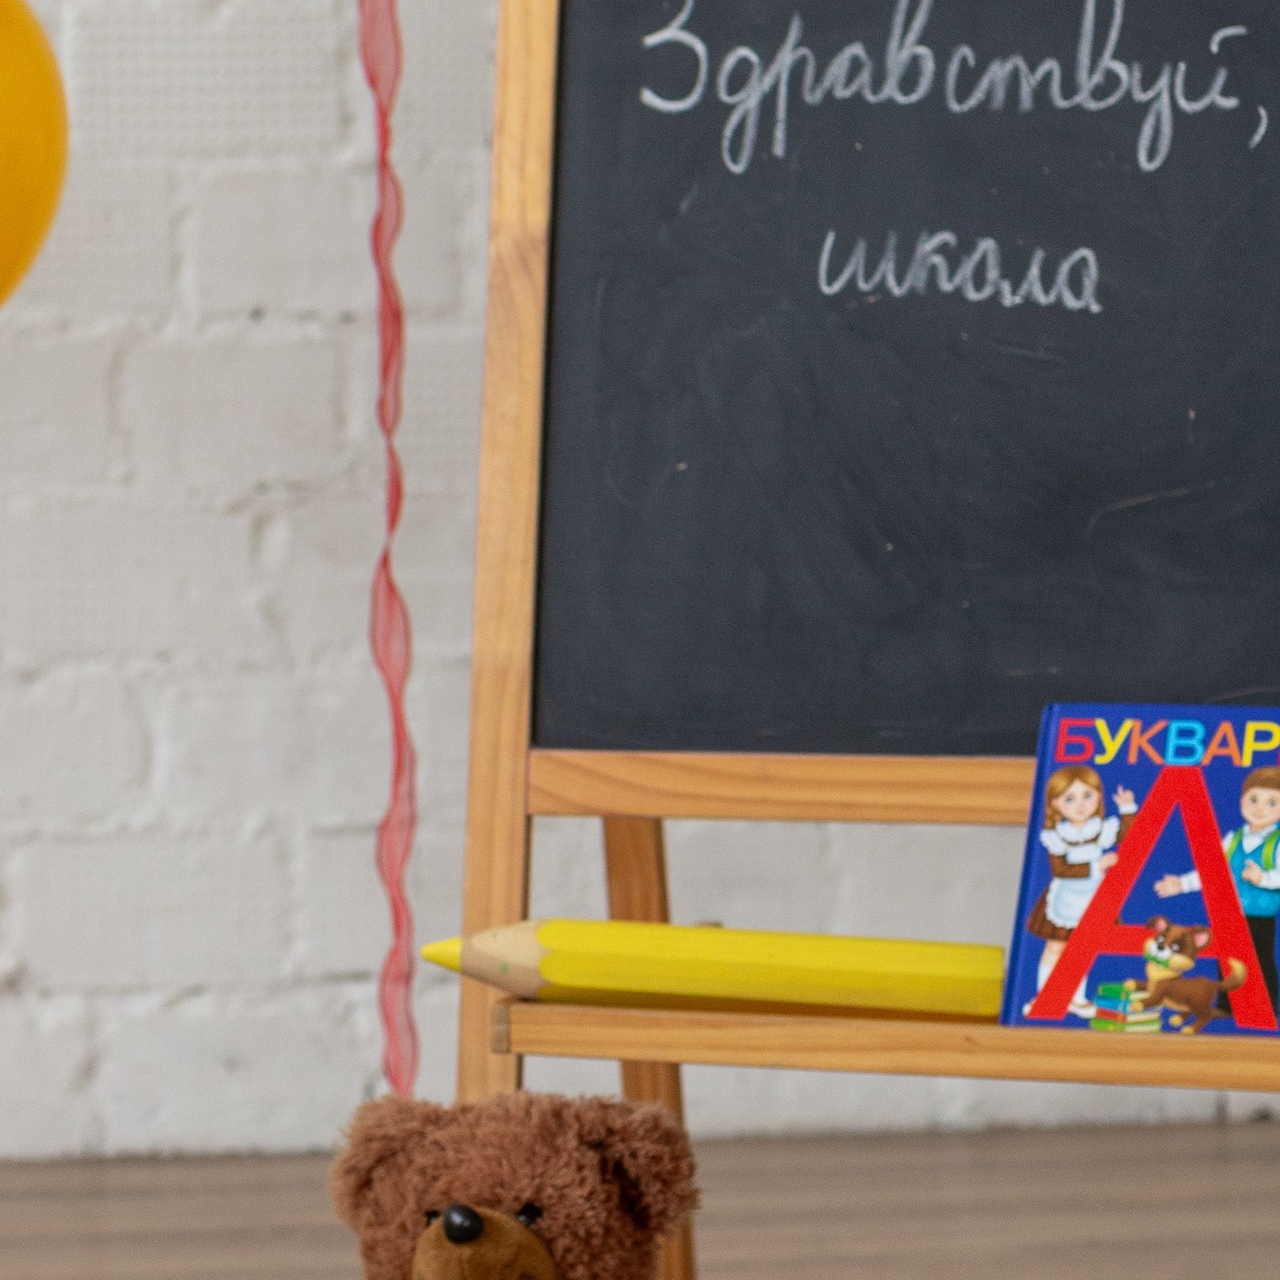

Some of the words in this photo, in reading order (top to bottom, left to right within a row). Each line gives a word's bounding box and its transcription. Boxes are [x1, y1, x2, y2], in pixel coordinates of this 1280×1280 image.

[819, 229, 1103, 313] школа
[1054, 717, 1280, 768] БУКВАР
[1024, 765, 1278, 1031] А
